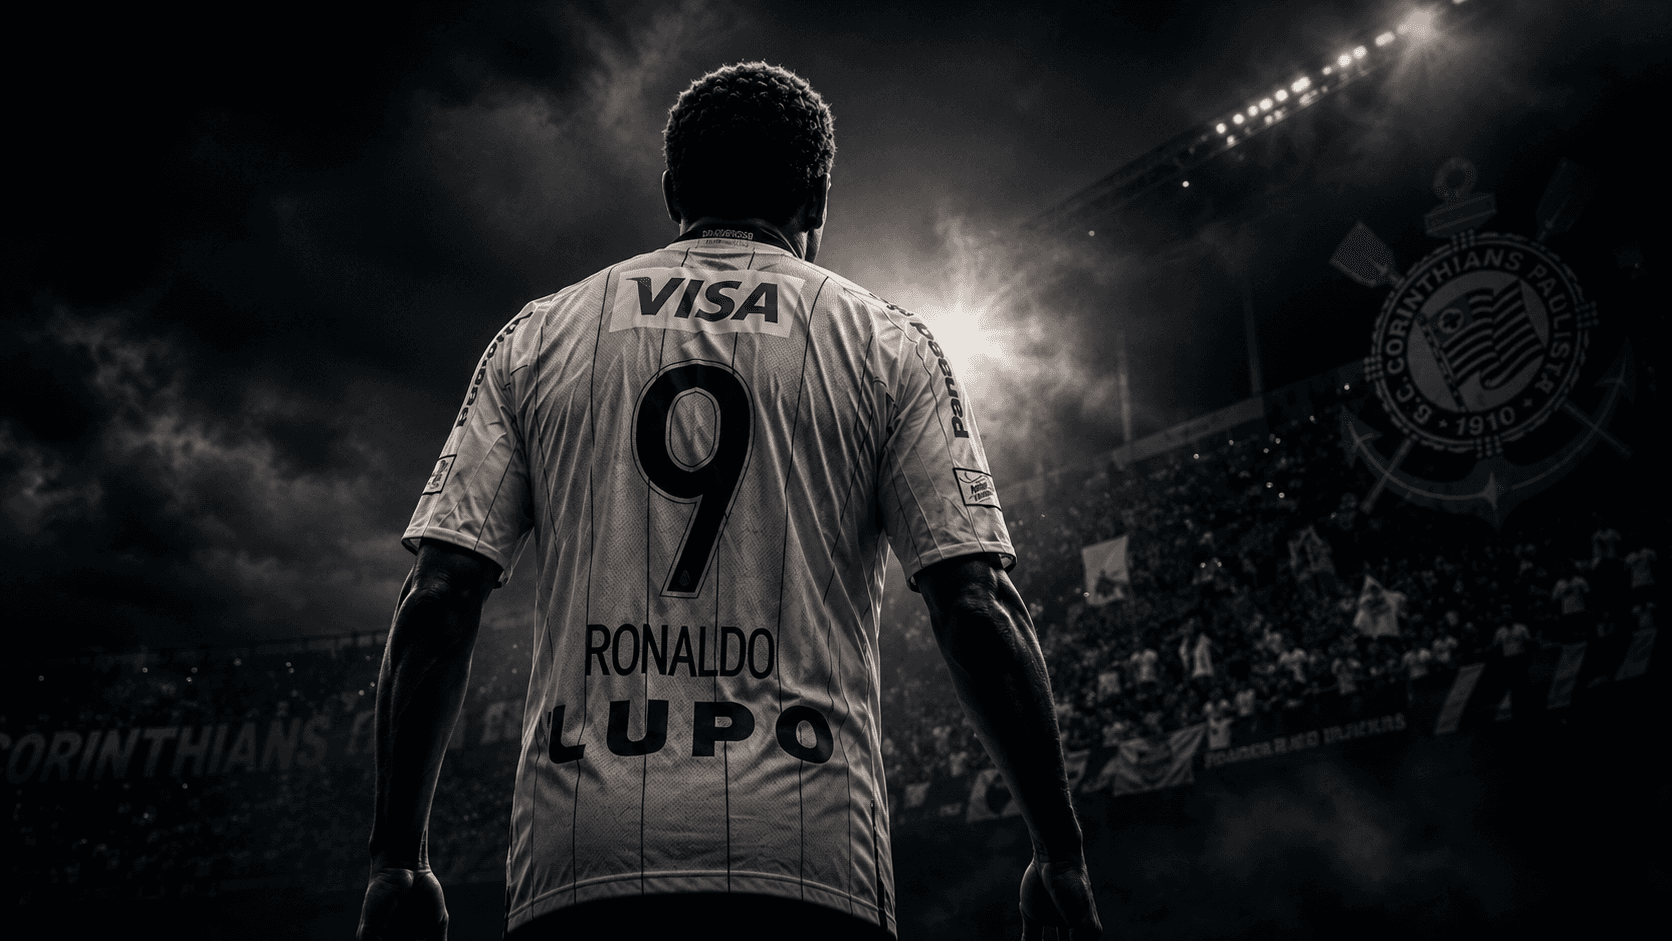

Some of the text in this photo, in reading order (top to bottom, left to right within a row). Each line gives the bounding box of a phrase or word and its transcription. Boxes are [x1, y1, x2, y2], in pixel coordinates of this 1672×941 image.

[626, 276, 780, 324] VISA
[631, 358, 756, 599] 9
[585, 624, 776, 680] RONALDO
[548, 699, 835, 765] LUPO
